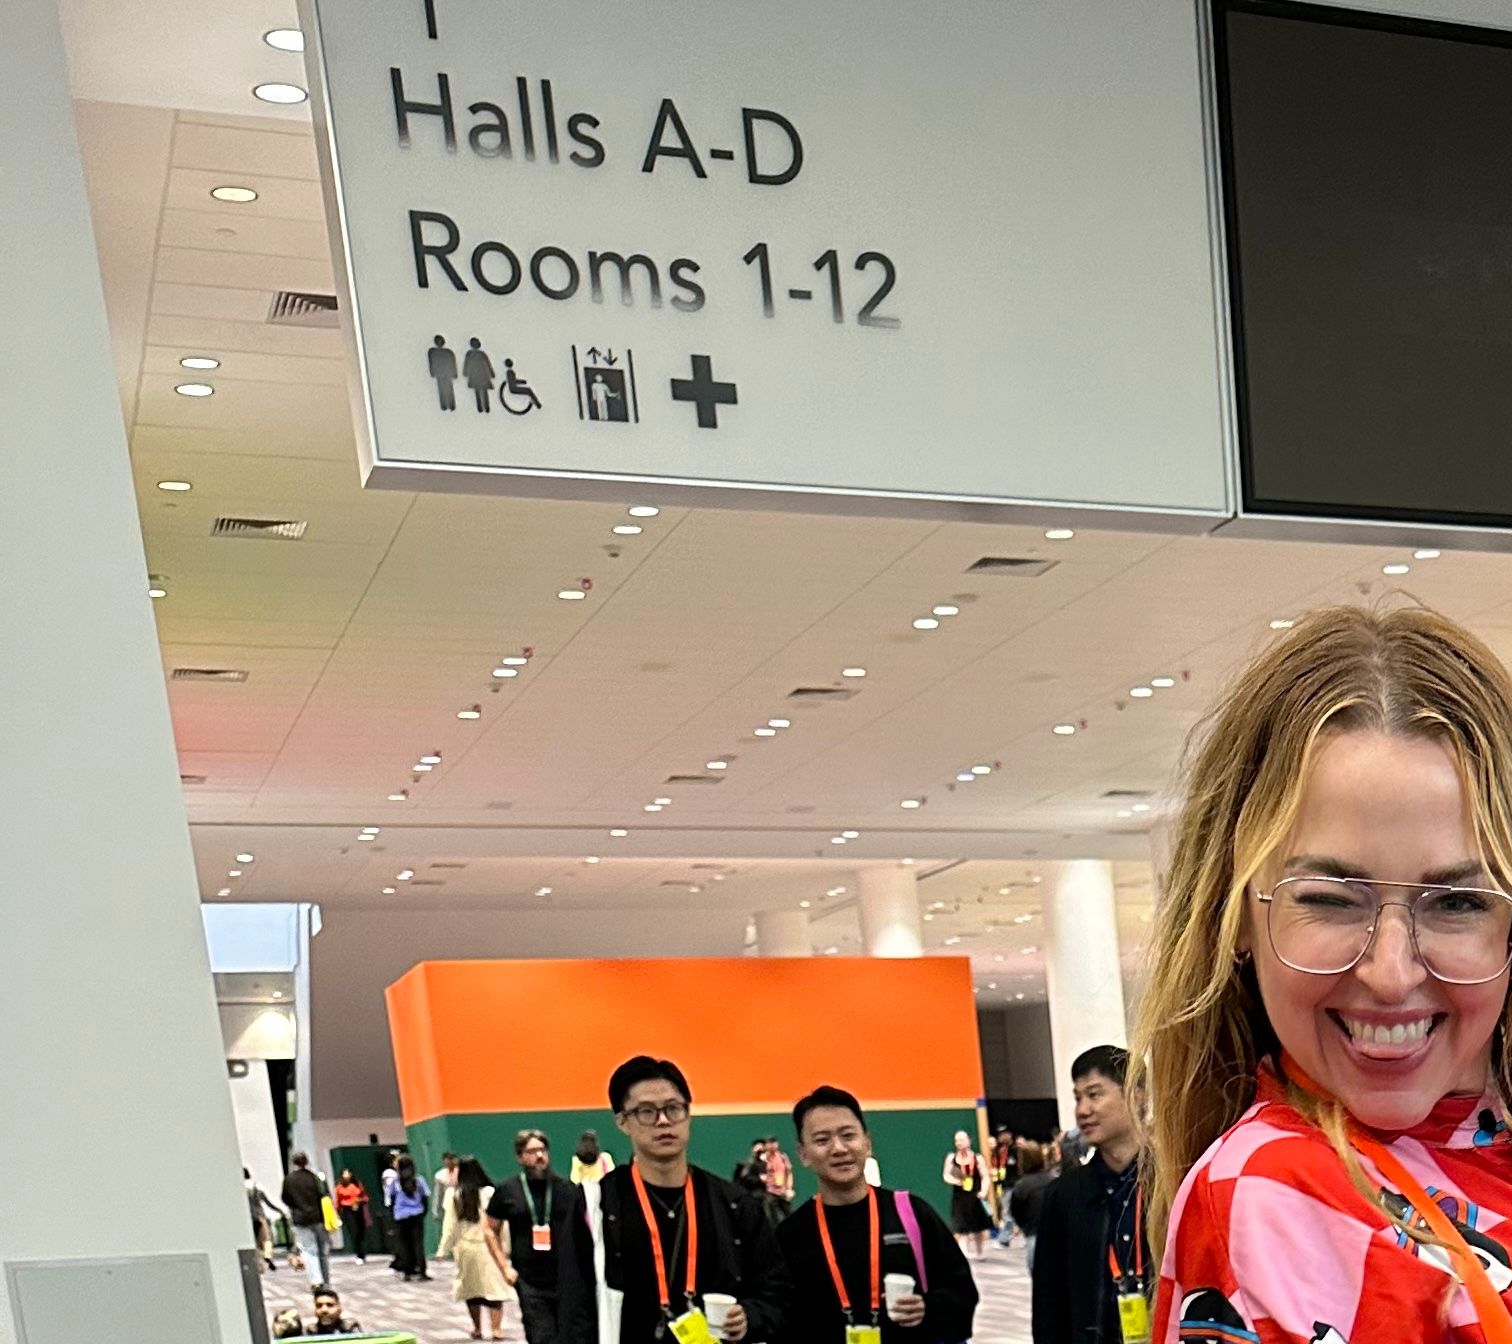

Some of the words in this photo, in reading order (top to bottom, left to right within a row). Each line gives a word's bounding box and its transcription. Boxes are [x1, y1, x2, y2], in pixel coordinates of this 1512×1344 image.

[390, 67, 606, 169] Halls
[641, 98, 803, 186] A-D
[408, 209, 706, 312] Rooms
[742, 242, 901, 329] 1-12
